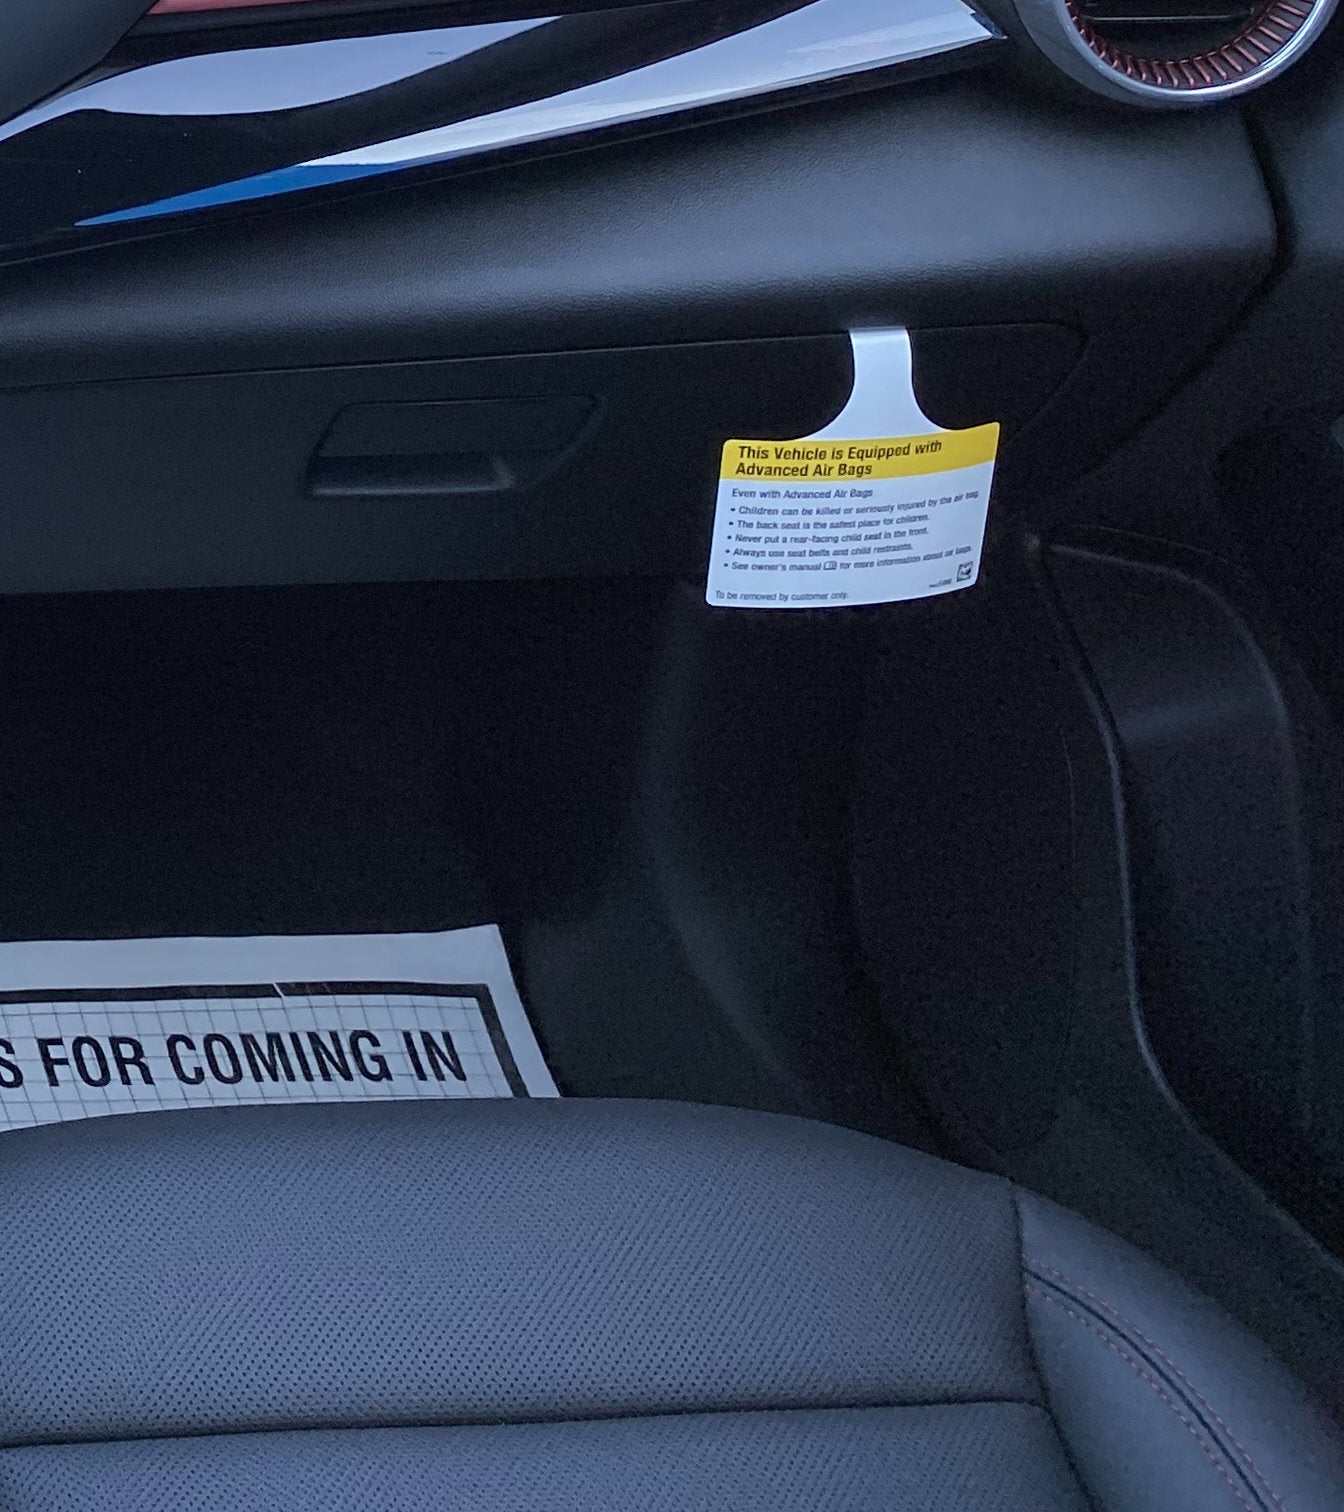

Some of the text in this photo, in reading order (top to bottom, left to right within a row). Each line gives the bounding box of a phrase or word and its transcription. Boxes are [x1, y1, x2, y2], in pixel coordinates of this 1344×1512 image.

[738, 440, 942, 461] This Vehicle is Equipped with
[736, 463, 872, 477] Advanced Air Bags
[732, 489, 873, 499] Even with Advanced Air Bags
[739, 506, 778, 515] Children
[737, 520, 753, 529] The
[735, 534, 762, 543] Never
[733, 548, 766, 558] Always
[740, 592, 777, 600] removed
[38, 1034, 154, 1088] FOR
[166, 1029, 390, 1085] COMING
[412, 1030, 466, 1082] IN
